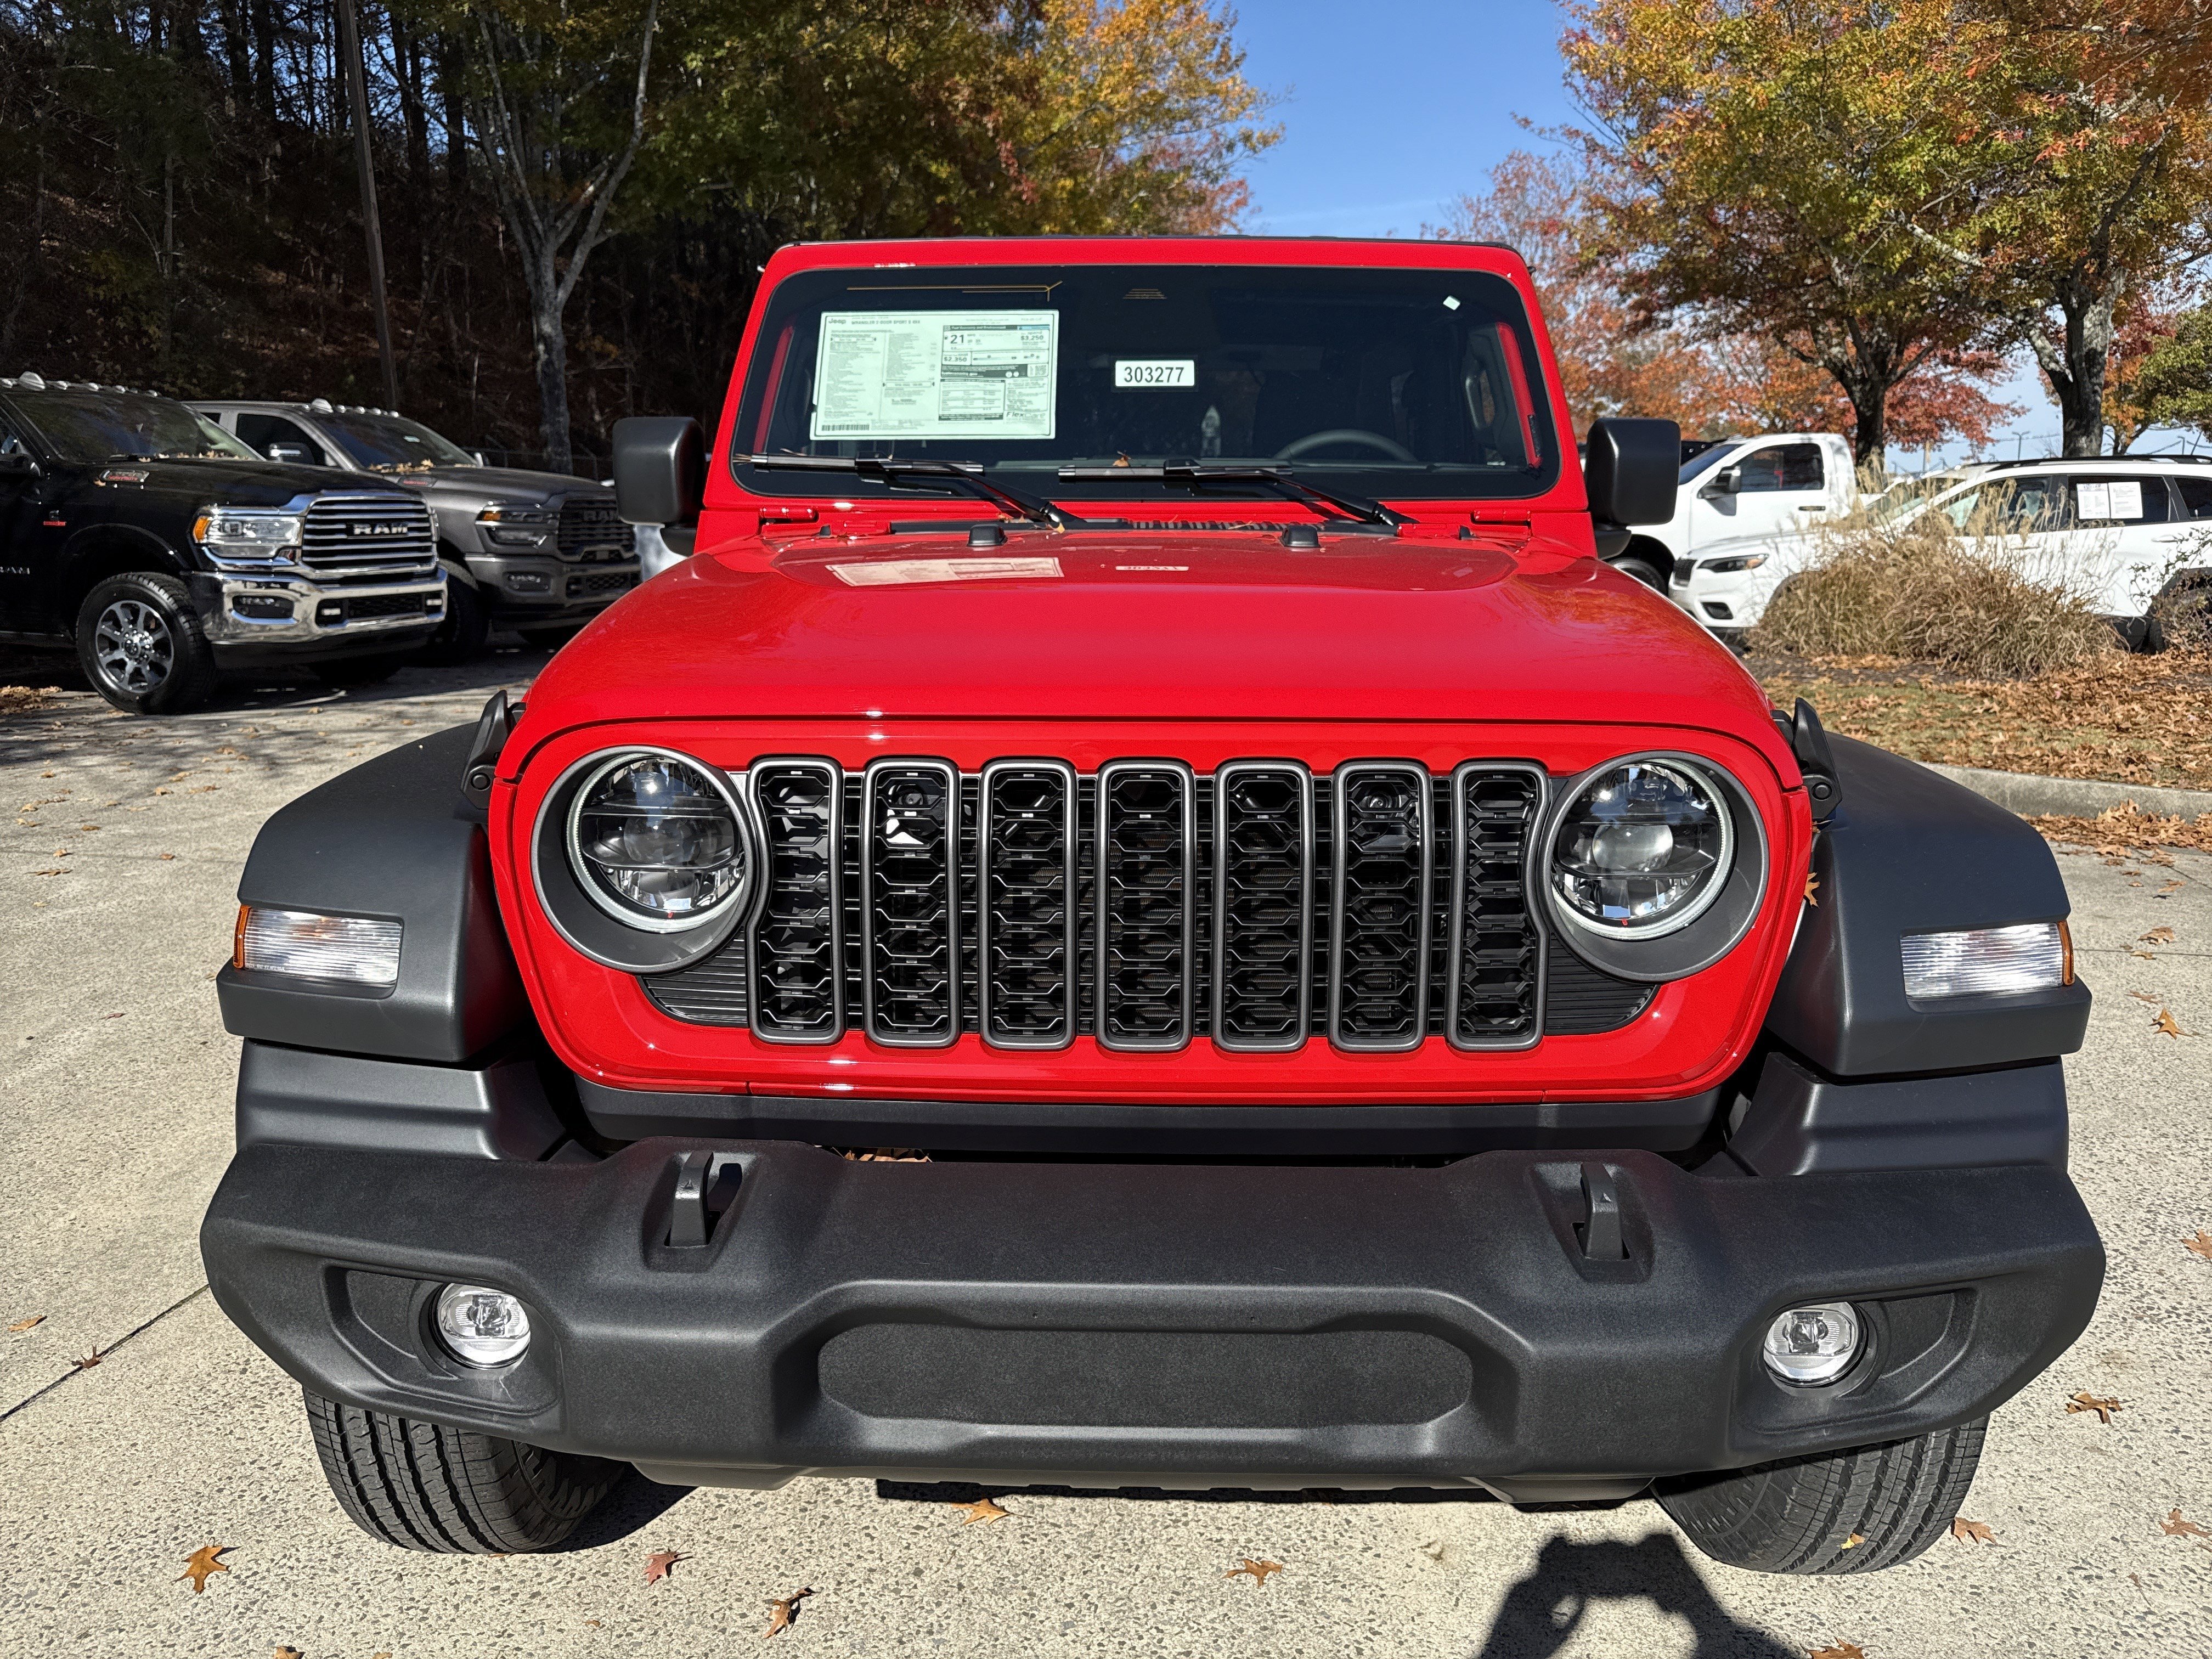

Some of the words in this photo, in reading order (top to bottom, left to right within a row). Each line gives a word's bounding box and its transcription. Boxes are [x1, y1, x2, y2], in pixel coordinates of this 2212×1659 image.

[950, 334, 964, 344] 21
[1124, 366, 1184, 383] 303277
[353, 523, 408, 535] RAM
